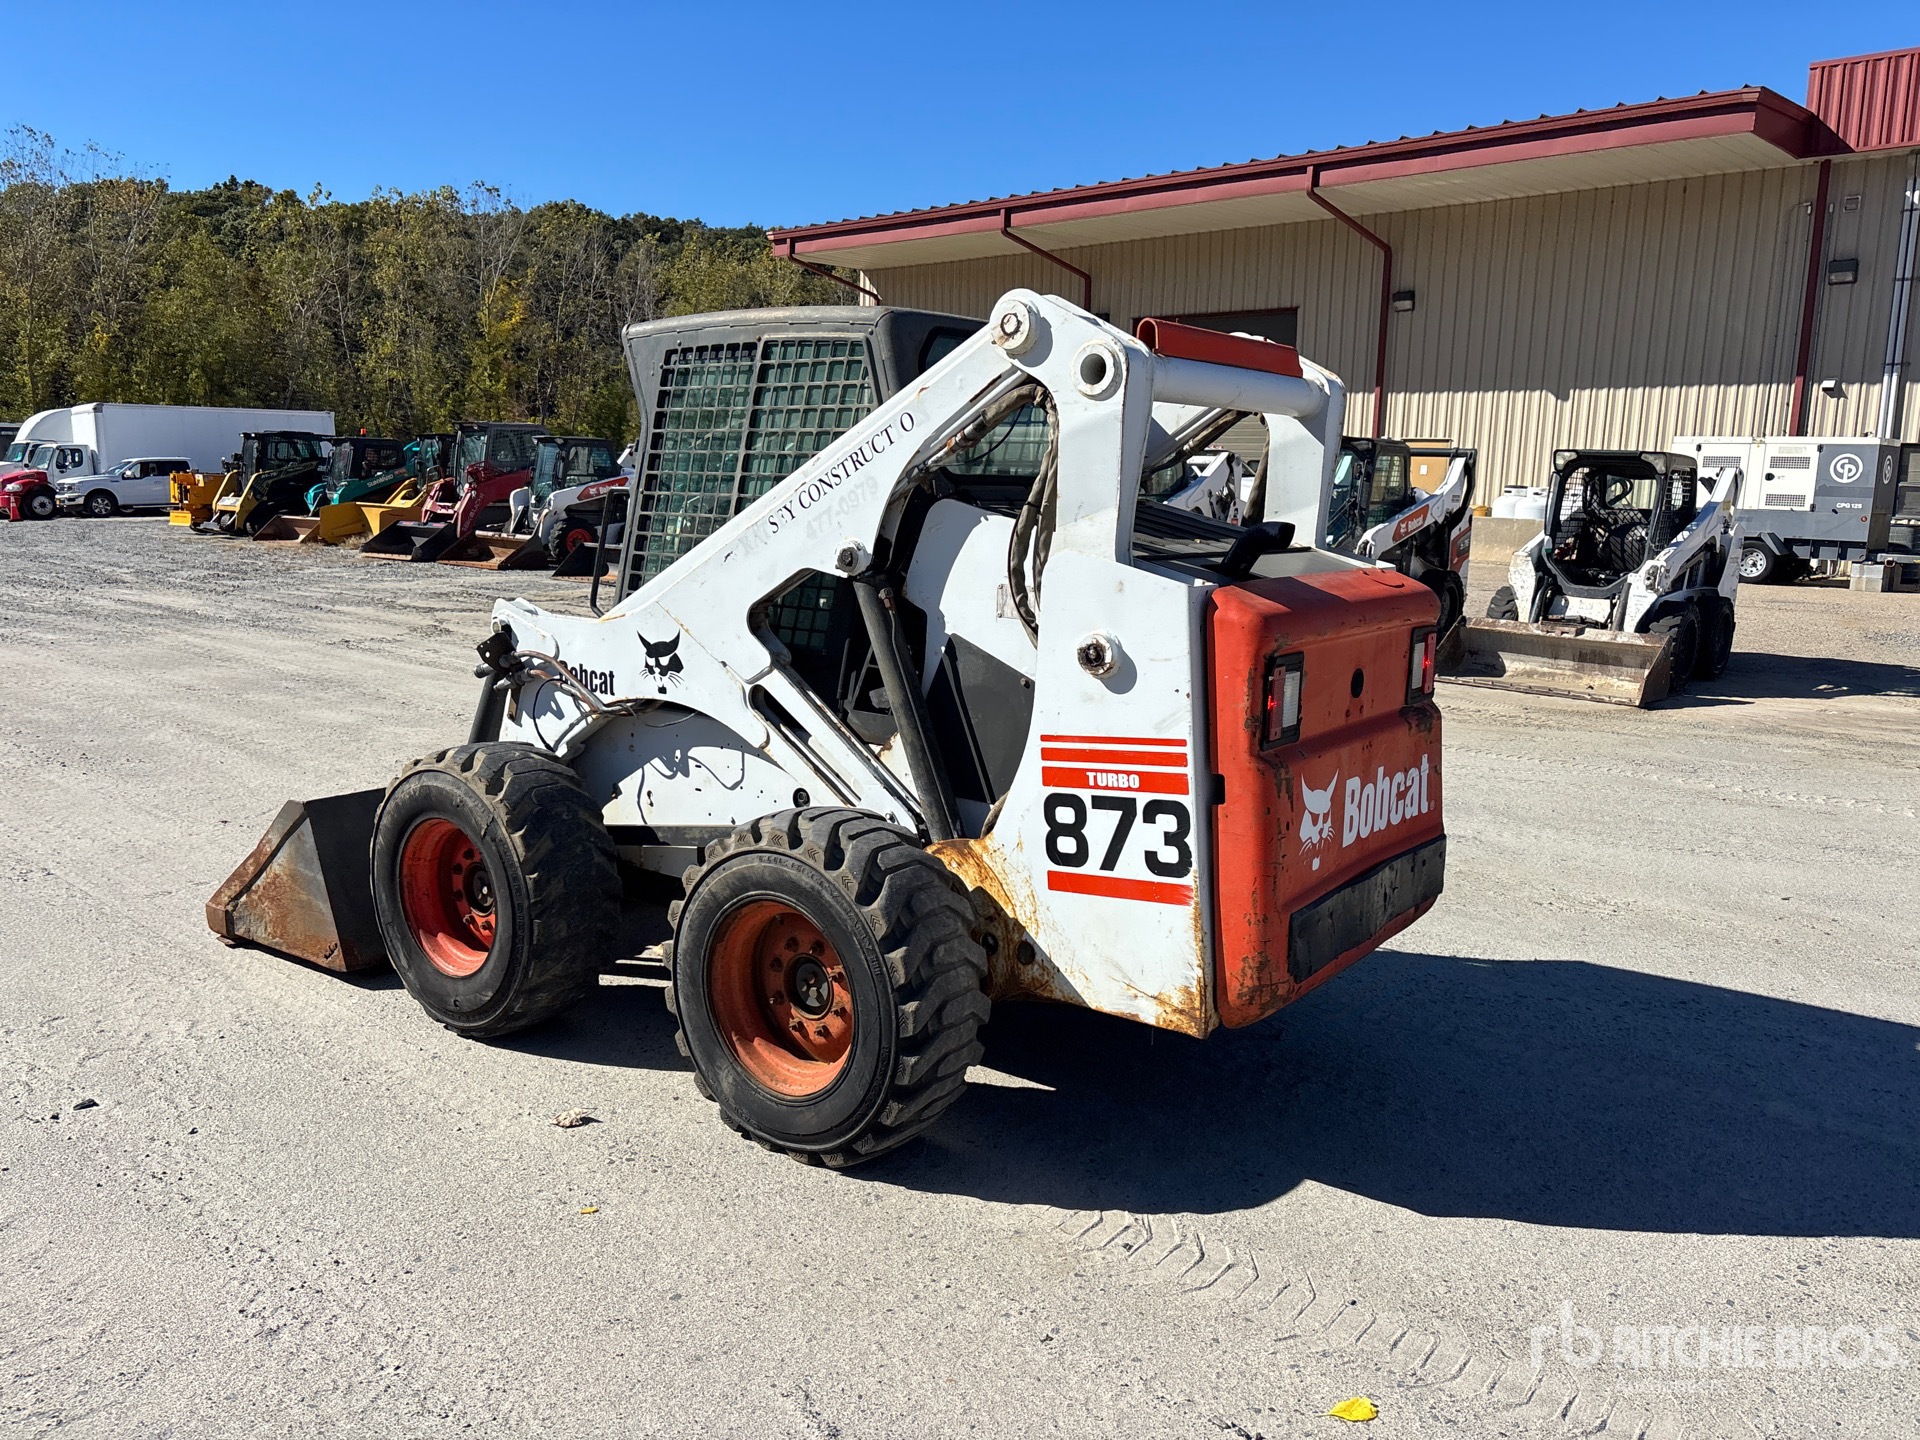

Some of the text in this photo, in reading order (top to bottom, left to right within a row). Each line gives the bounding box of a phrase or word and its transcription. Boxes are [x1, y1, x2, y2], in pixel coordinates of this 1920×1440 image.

[1086, 771, 1140, 790] TURBO
[1342, 753, 1429, 848] Bobcat
[1043, 792, 1193, 879] 873
